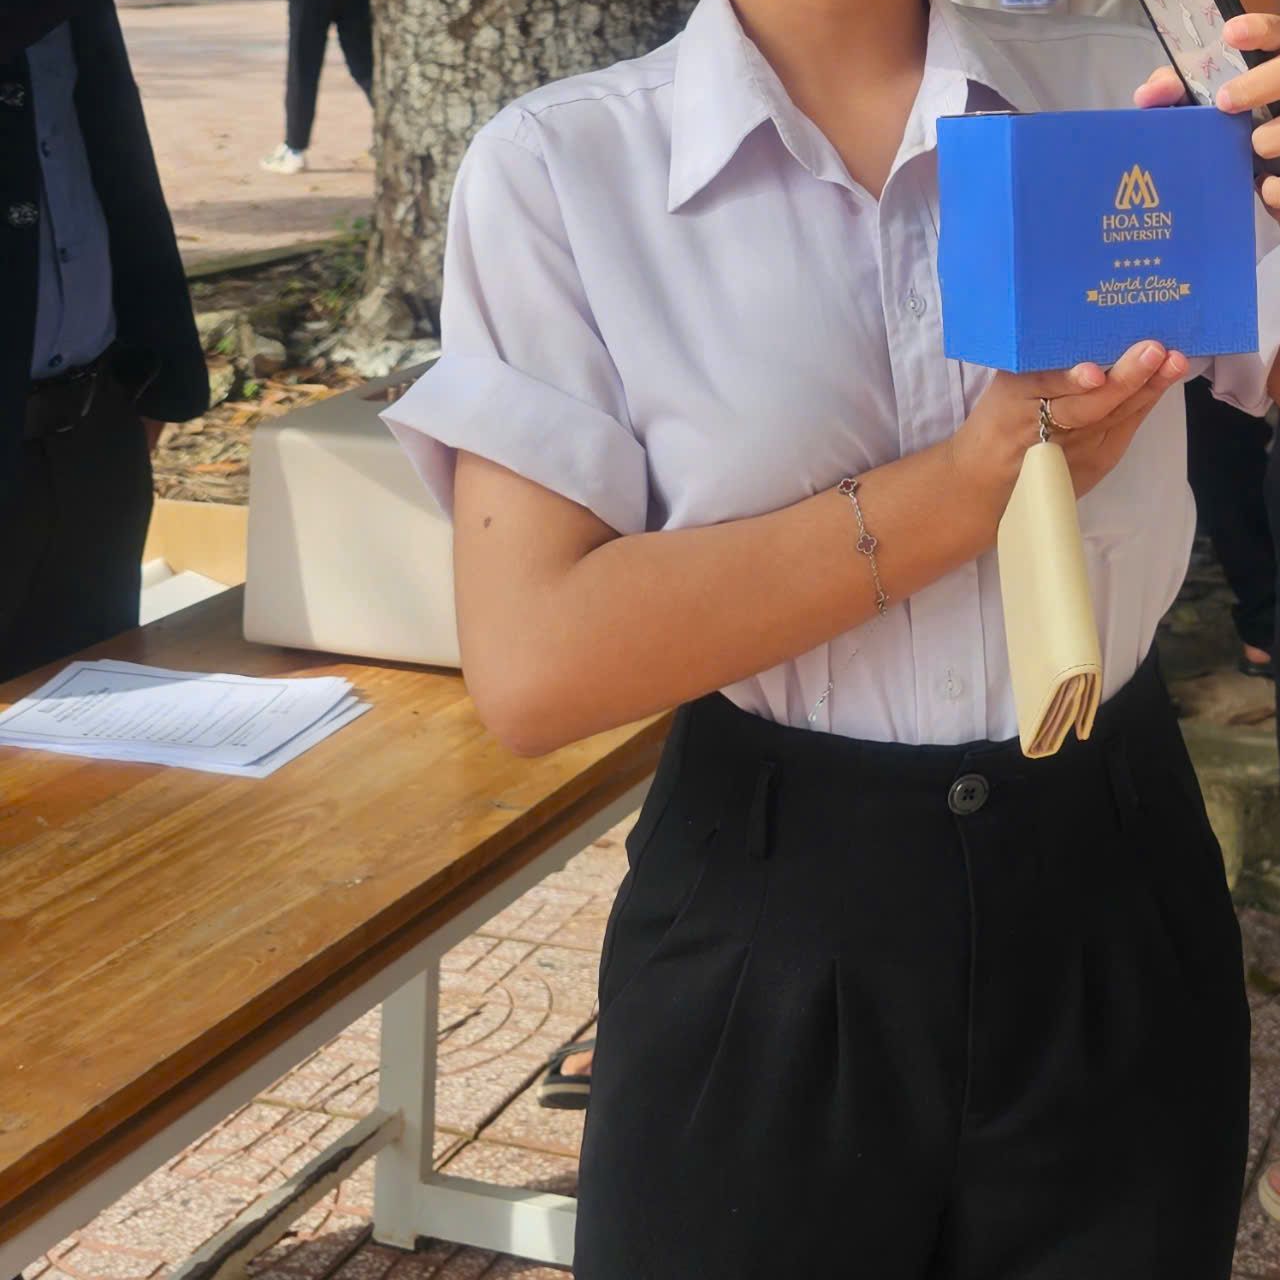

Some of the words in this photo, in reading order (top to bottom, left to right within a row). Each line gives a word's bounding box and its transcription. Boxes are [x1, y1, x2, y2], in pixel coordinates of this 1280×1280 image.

[1103, 213, 1140, 230] HOA
[1143, 211, 1172, 228] SEN
[1103, 228, 1172, 243] UNIVERSITY
[1099, 276, 1141, 293] World
[1144, 275, 1177, 290] Class
[1098, 287, 1180, 306] EDUCATION
